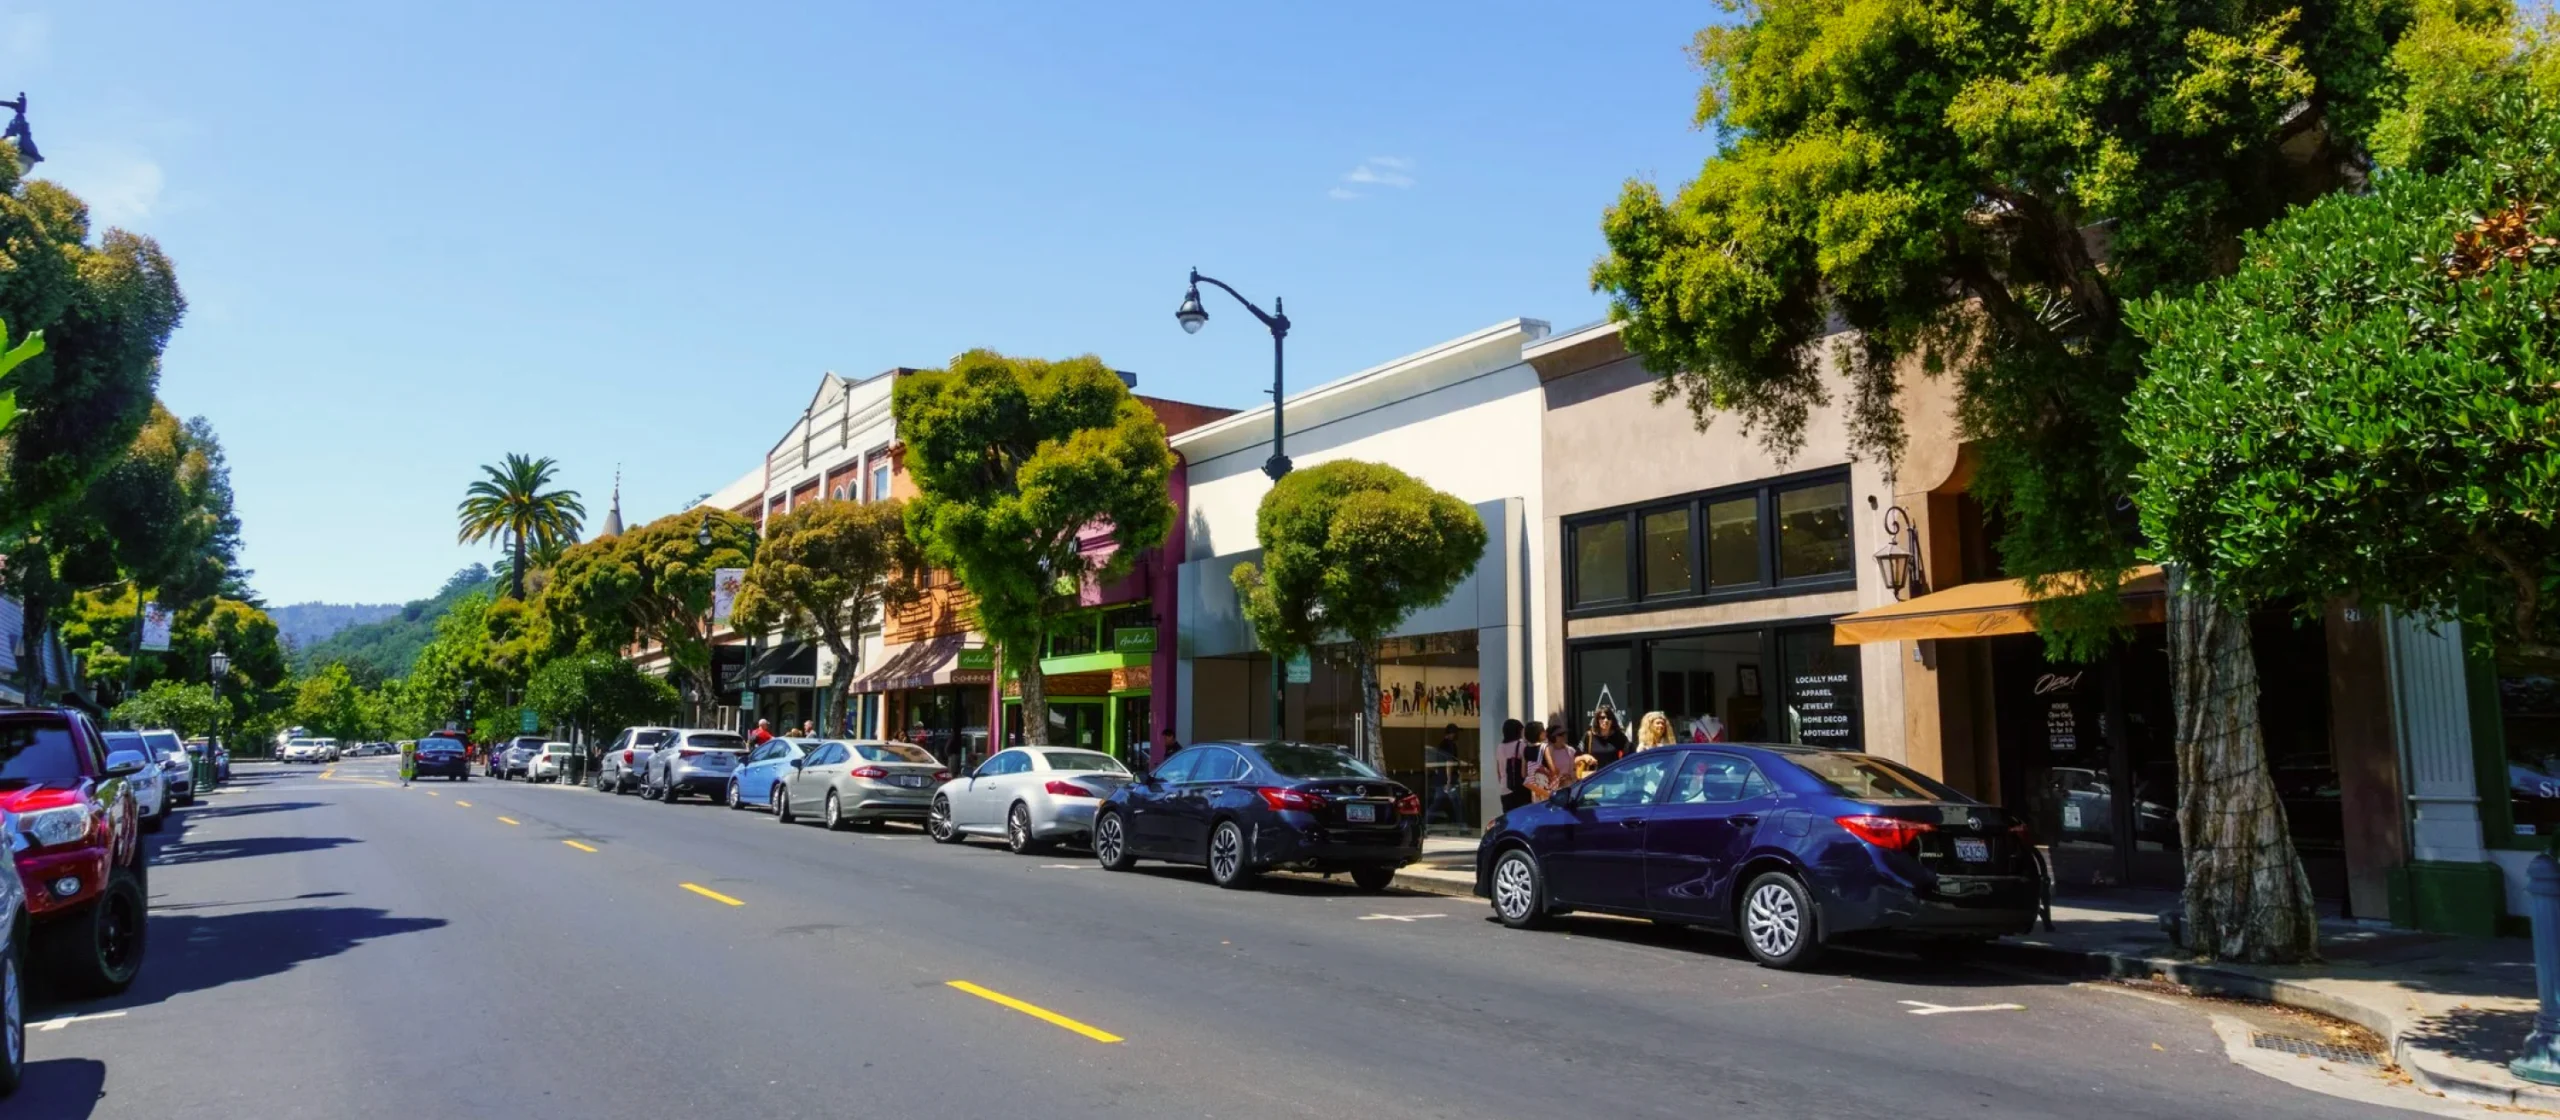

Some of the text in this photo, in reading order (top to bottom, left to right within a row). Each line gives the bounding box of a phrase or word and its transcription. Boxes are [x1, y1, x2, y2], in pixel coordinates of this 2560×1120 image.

[773, 676, 811, 685] JEWELERS
[1795, 674, 1848, 684] LOCALLY MADE
[1802, 702, 1834, 710] JEWELRY
[1823, 715, 1848, 723] DECOR
[1803, 729, 1849, 737] APOTHECARY
